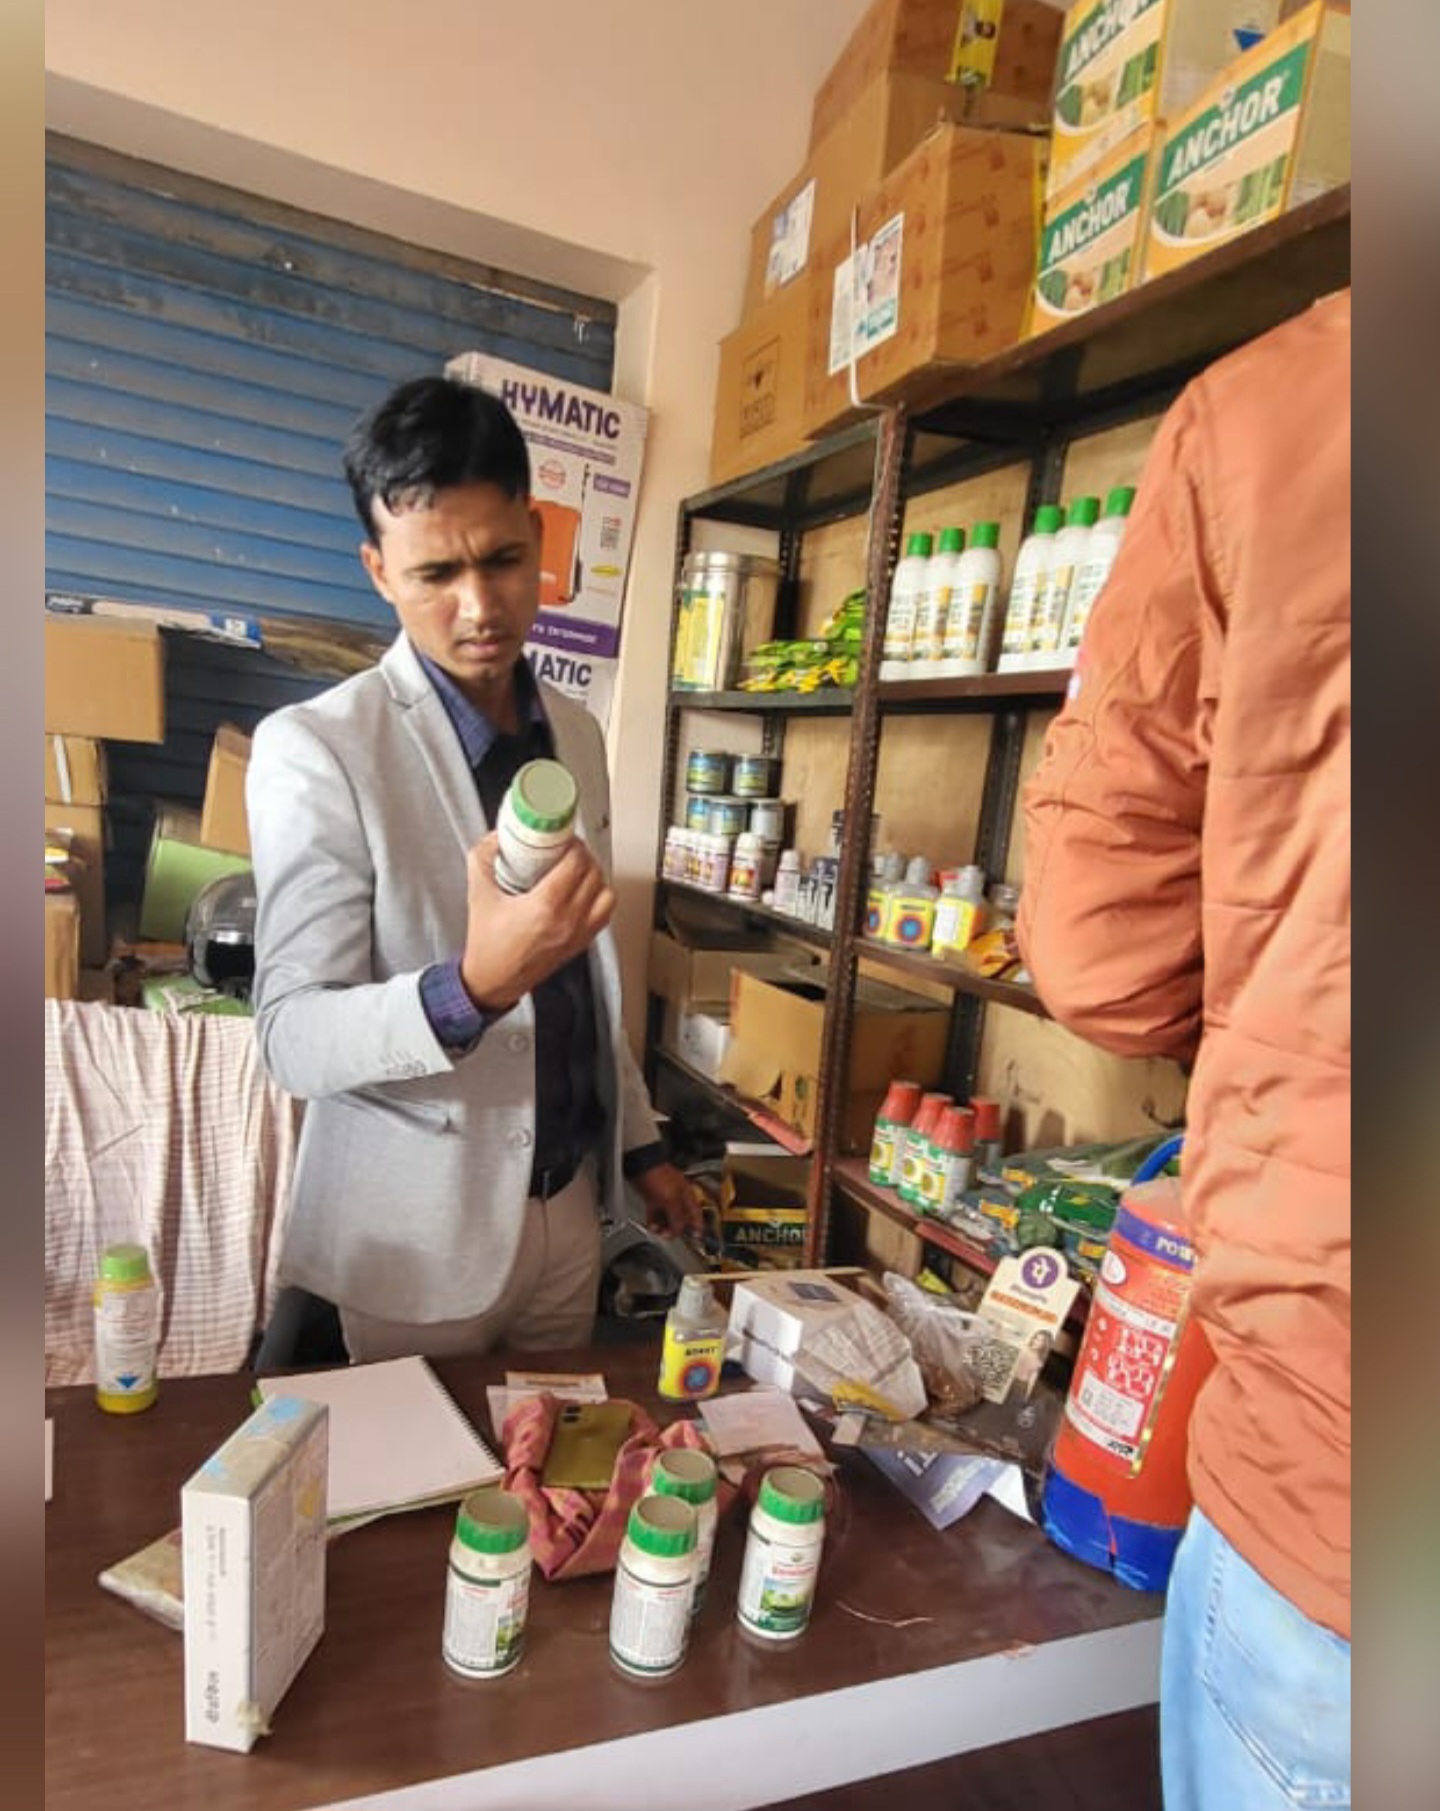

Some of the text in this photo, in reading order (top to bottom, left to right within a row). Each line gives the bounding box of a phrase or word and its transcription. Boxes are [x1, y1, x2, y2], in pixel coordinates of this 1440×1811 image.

[1064, 0, 1152, 80] ANCHO
[1166, 76, 1282, 187] ANCHOR
[1047, 179, 1128, 264] ANCHOR
[502, 379, 620, 439] HYMATIC
